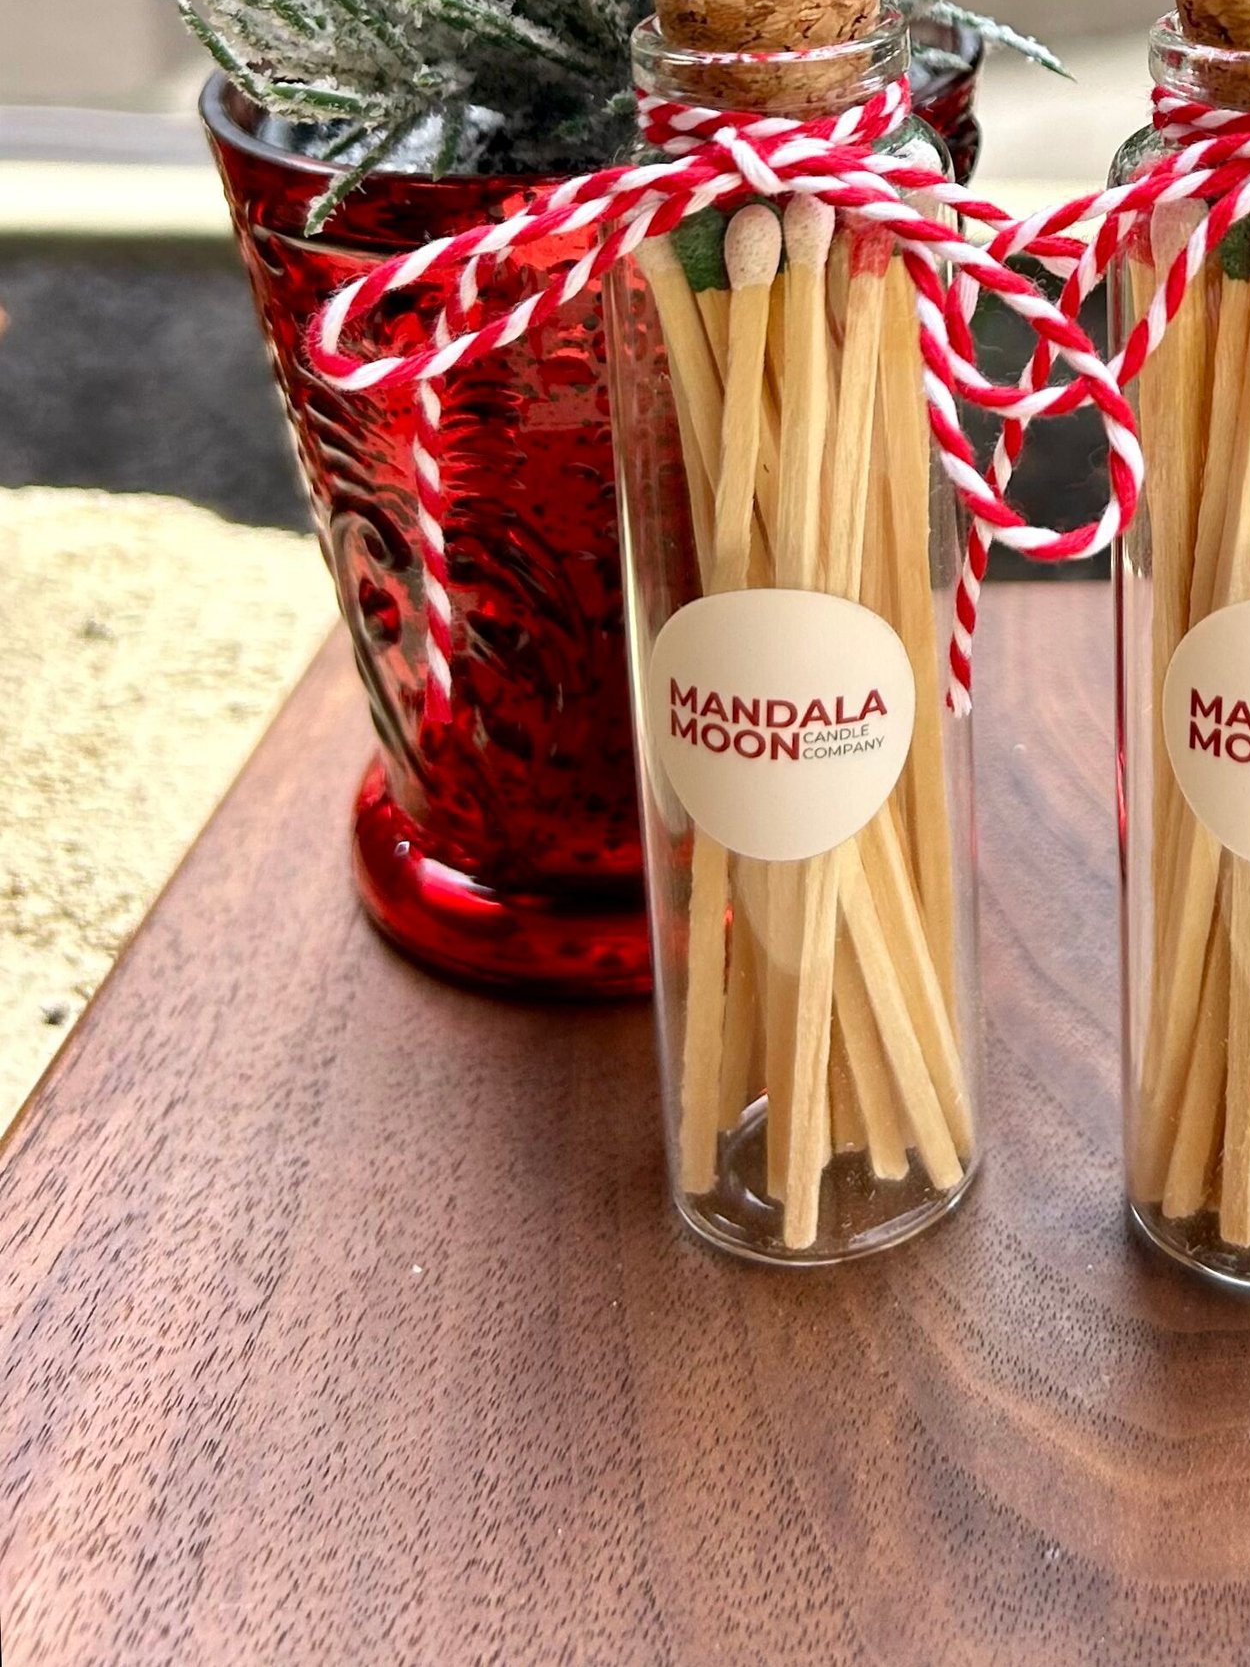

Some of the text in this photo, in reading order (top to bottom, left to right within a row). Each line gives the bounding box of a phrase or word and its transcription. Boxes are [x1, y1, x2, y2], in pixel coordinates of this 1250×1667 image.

[670, 677, 888, 728] MANDALA
[671, 709, 800, 760] MOON
[802, 736, 885, 760] COMPANY
[803, 724, 870, 744] CANDLE
